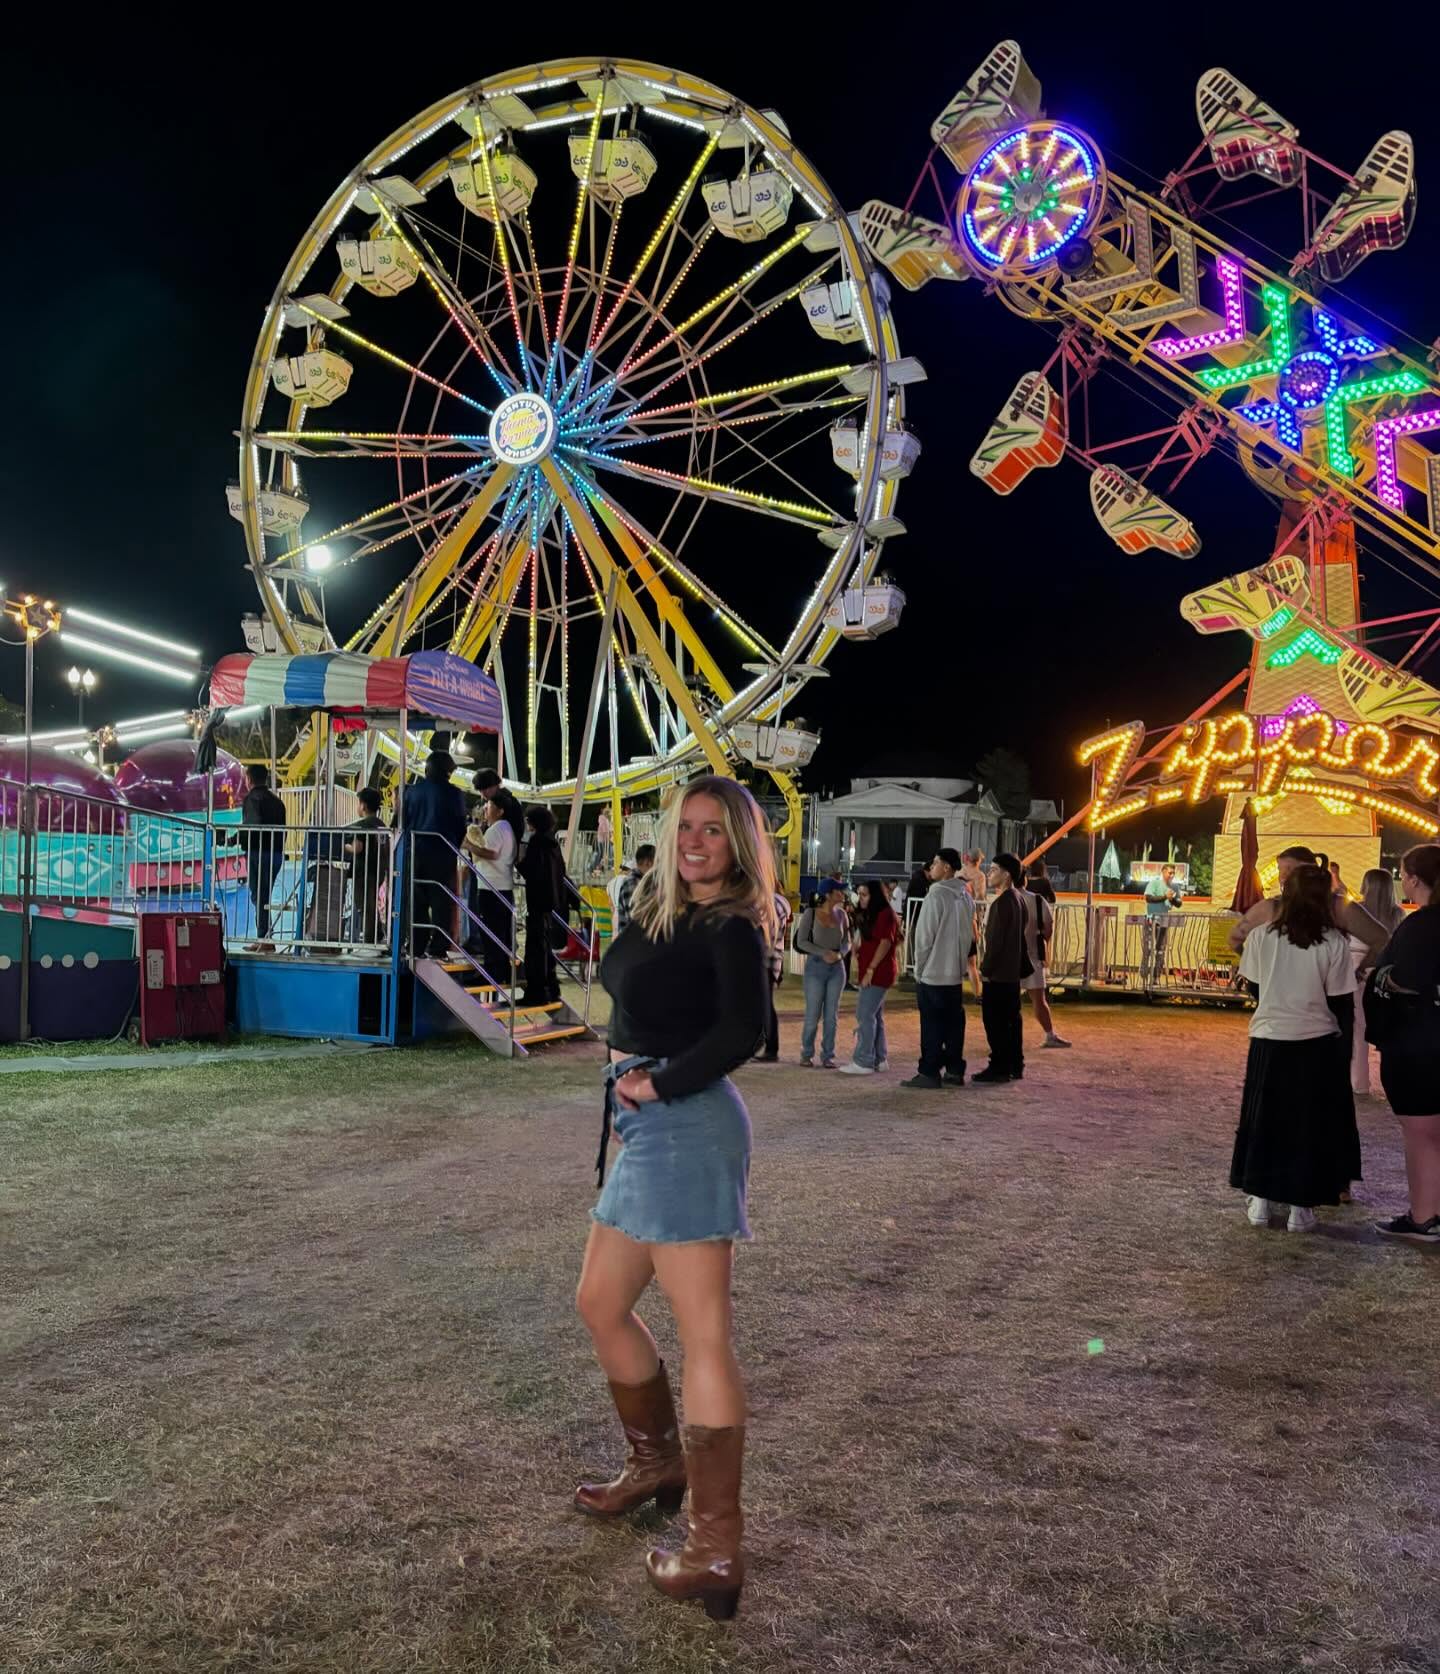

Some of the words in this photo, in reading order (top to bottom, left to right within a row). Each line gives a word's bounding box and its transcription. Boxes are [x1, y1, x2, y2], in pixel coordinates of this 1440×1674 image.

[500, 400, 543, 420] CENTURY
[505, 445, 538, 459] WHEEL
[1079, 711, 1440, 832] Zipper
